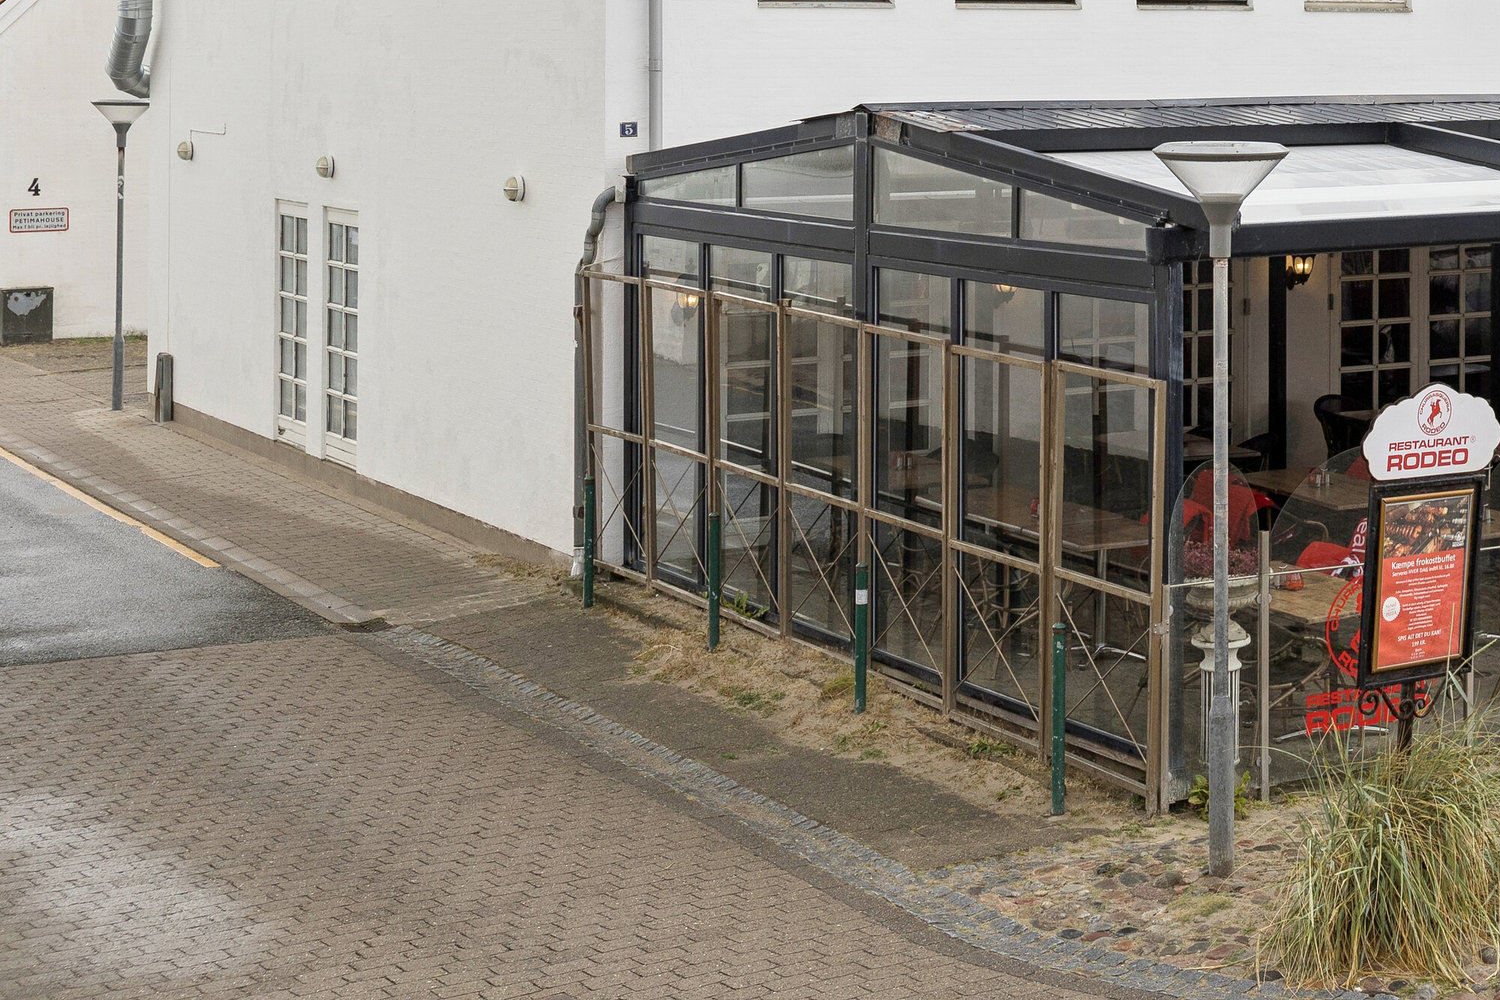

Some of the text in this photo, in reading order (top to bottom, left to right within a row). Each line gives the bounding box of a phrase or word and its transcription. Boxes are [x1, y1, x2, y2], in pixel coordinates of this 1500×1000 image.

[624, 123, 634, 136] 5
[27, 177, 41, 197] 4
[34, 210, 66, 218] parkering
[1421, 421, 1446, 434] RODEO
[1388, 436, 1470, 452] RESTAURANT
[1386, 448, 1469, 473] RODEO
[1391, 554, 1457, 571] Kæmpe frokostbuffet
